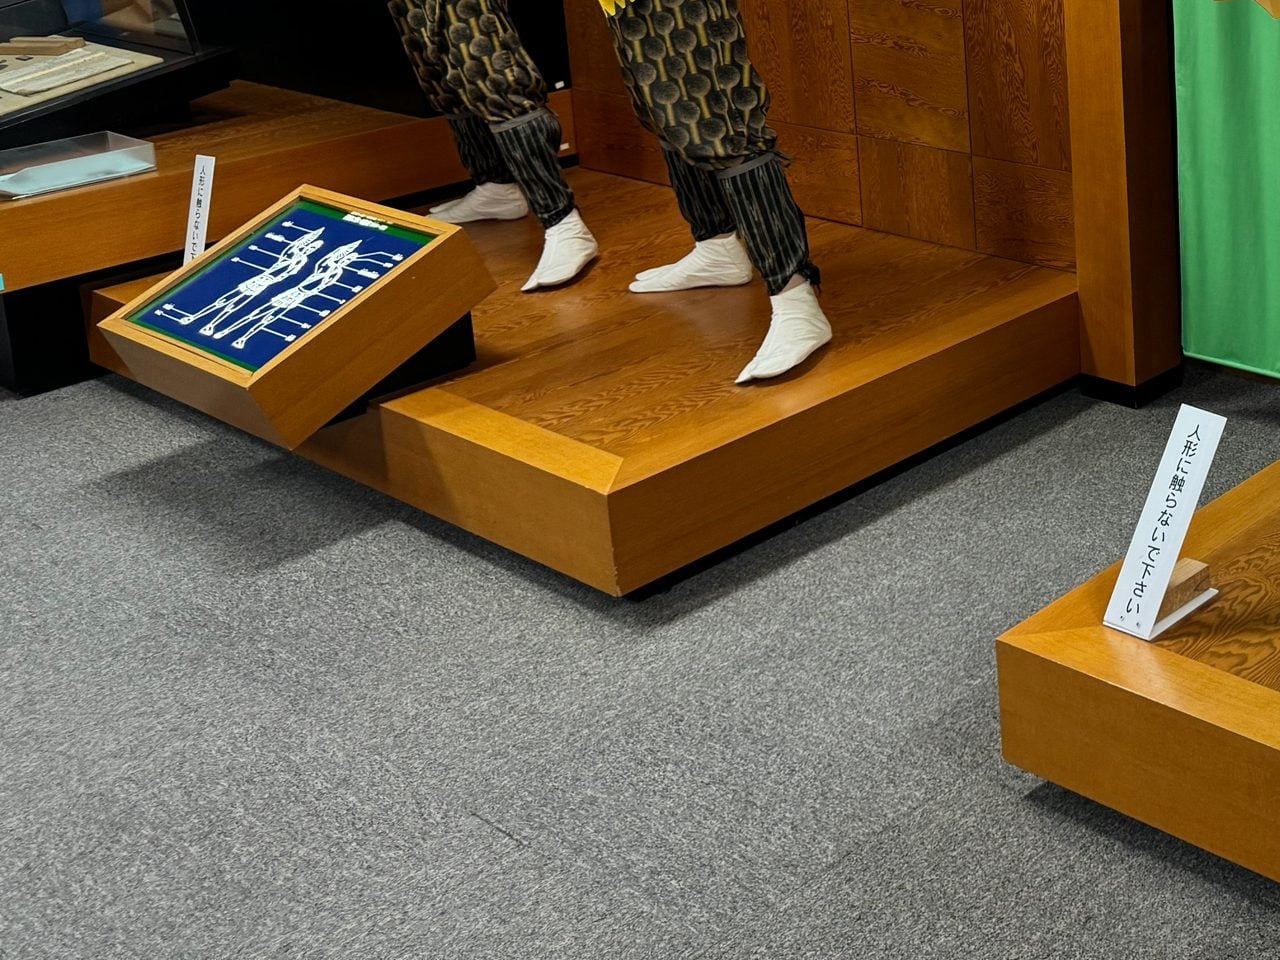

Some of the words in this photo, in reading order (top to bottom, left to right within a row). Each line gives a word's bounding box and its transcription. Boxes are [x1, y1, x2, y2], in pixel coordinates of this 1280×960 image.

[1126, 424, 1201, 614] 人形に触らないで下さい
